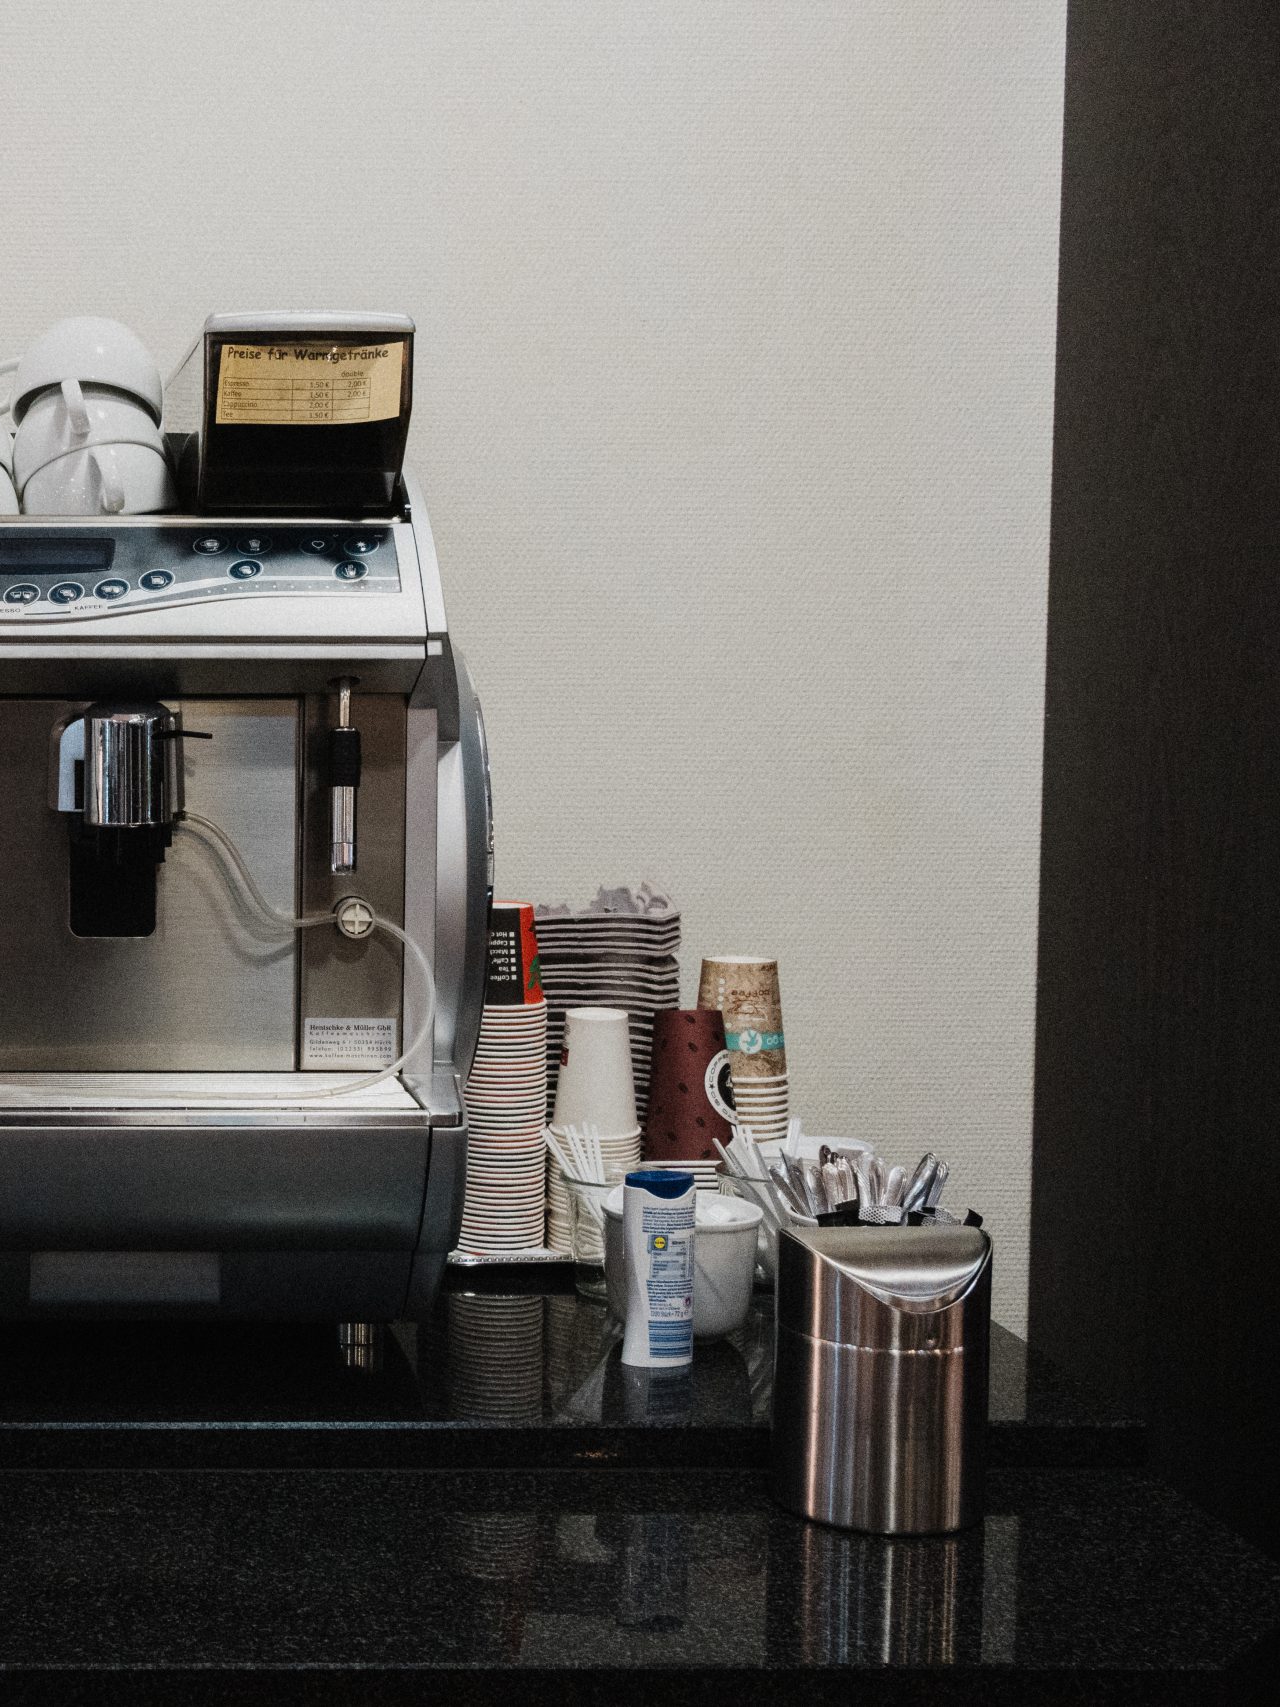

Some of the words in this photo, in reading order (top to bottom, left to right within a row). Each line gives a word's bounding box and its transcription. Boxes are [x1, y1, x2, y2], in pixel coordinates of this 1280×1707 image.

[227, 346, 261, 359] Preise
[267, 347, 288, 360] für
[293, 346, 389, 364] Warmgetränke
[340, 370, 364, 378] double
[309, 381, 324, 389] 1,50
[309, 401, 324, 409] 2,00
[222, 410, 234, 418] Tee
[309, 411, 324, 419] 1,50
